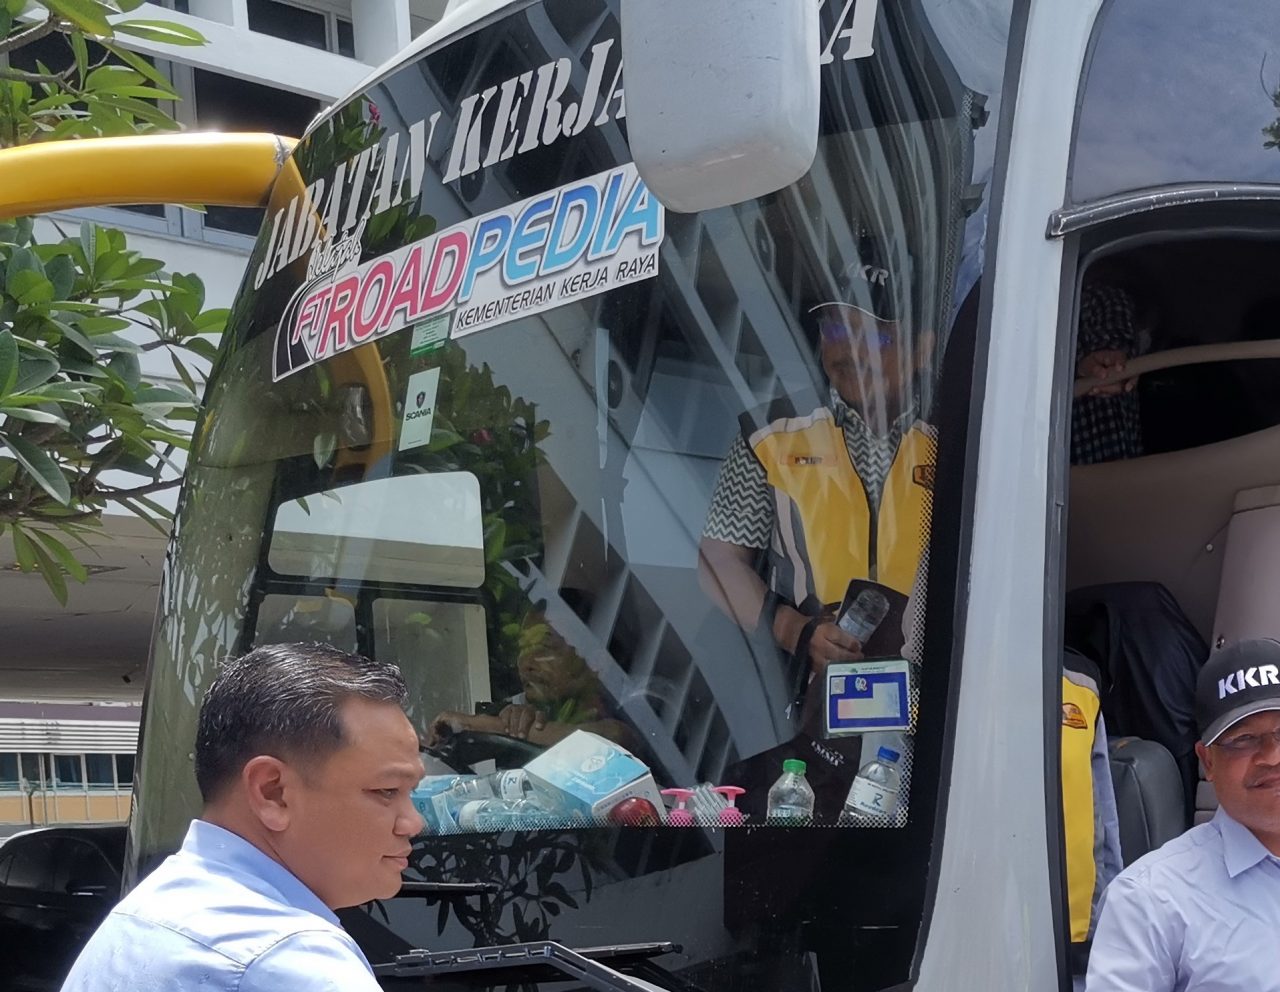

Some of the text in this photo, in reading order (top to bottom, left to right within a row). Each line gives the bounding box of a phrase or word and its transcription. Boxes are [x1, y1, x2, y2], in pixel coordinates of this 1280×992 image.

[254, 111, 441, 290] JABATAN
[456, 253, 656, 329] KEMENTERIAN KERJA RAYA
[405, 408, 432, 421] SCANIA
[1217, 663, 1280, 700] KKR
